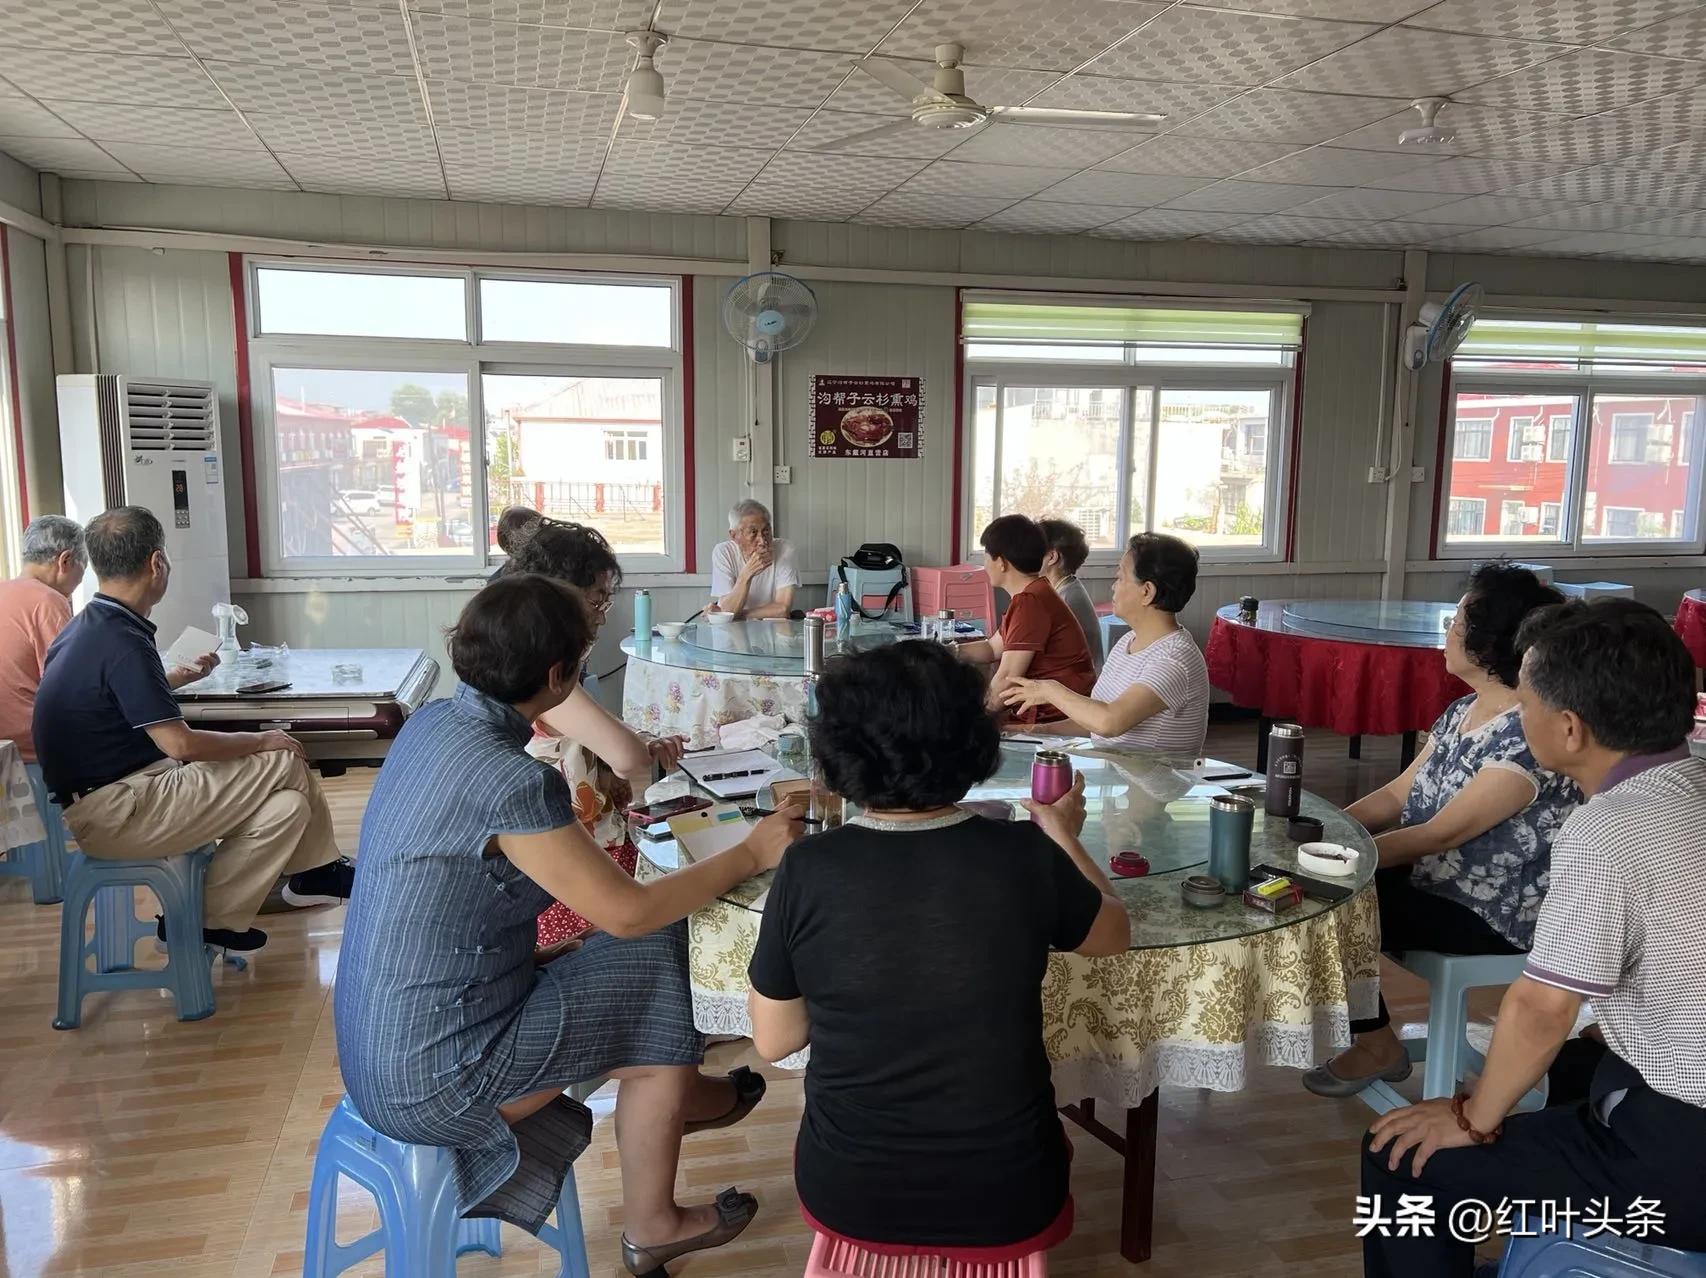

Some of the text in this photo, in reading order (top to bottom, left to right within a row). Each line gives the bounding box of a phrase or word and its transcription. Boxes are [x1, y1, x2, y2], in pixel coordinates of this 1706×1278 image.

[817, 392, 918, 407] 沟帮子云杉熏鸡
